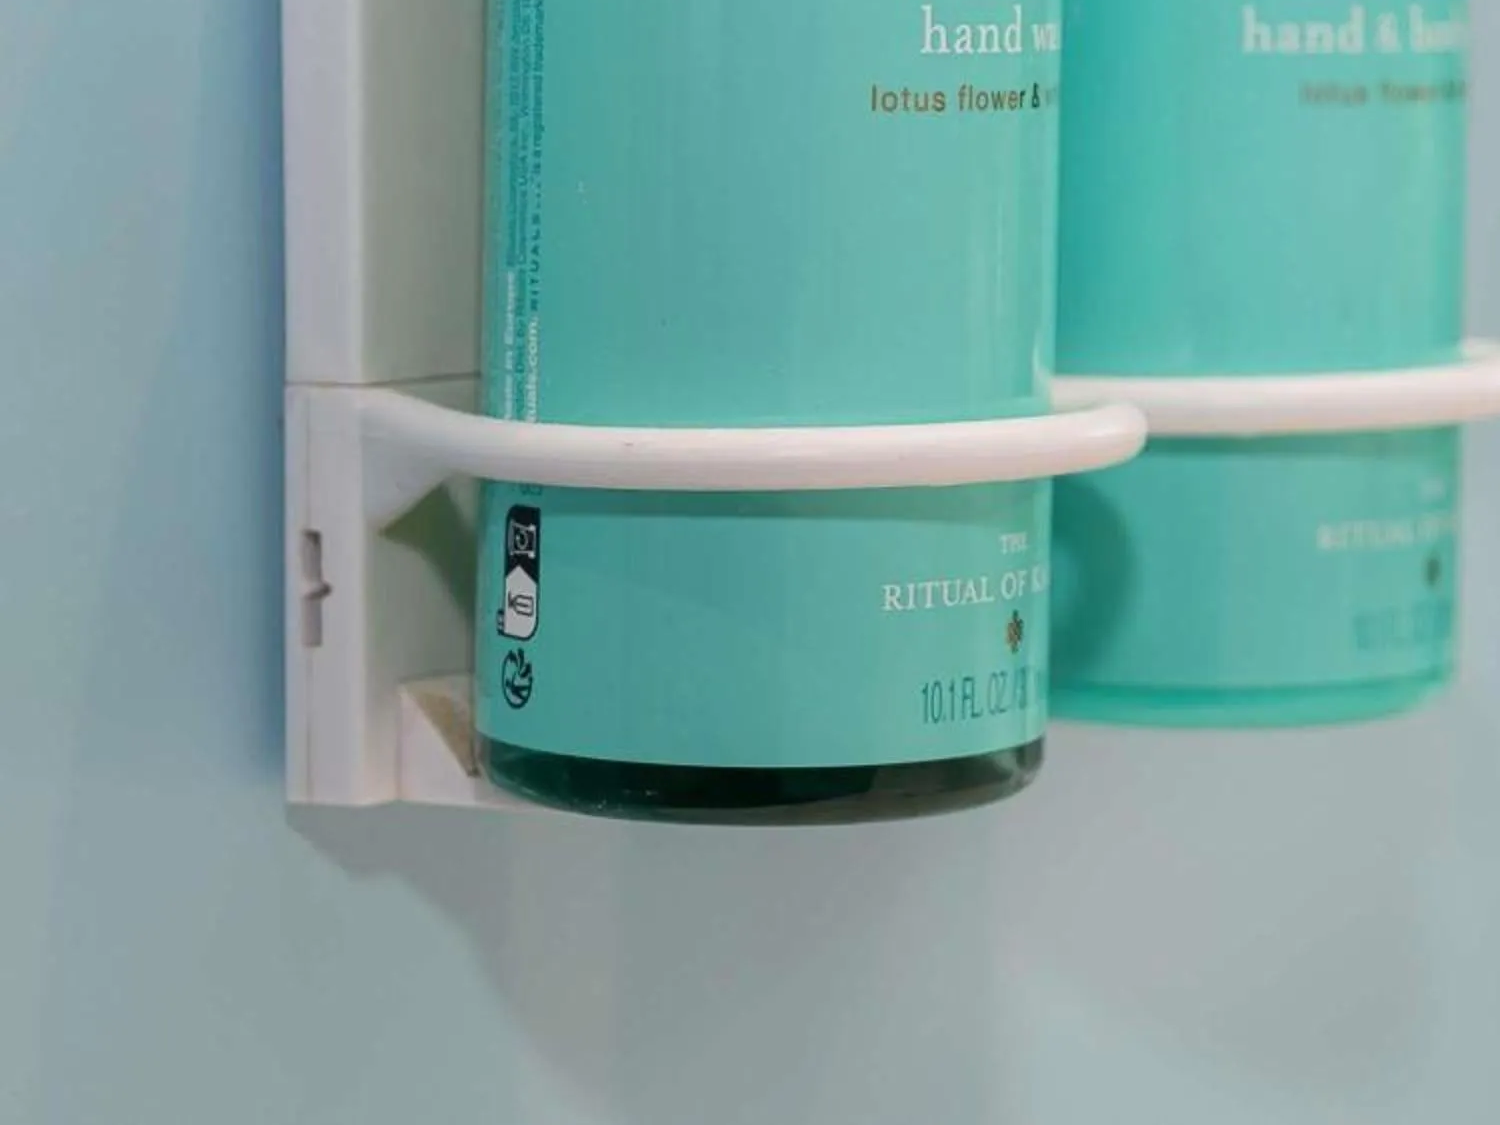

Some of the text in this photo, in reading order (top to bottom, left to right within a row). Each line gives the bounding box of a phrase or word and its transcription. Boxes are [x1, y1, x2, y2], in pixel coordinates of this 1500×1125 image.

[920, 4, 1023, 54] hand
[1241, 3, 1365, 54] hand
[871, 84, 946, 112] lotus
[958, 83, 1025, 111] flower
[881, 576, 995, 611] RITUAL
[1001, 570, 1029, 600] OF
